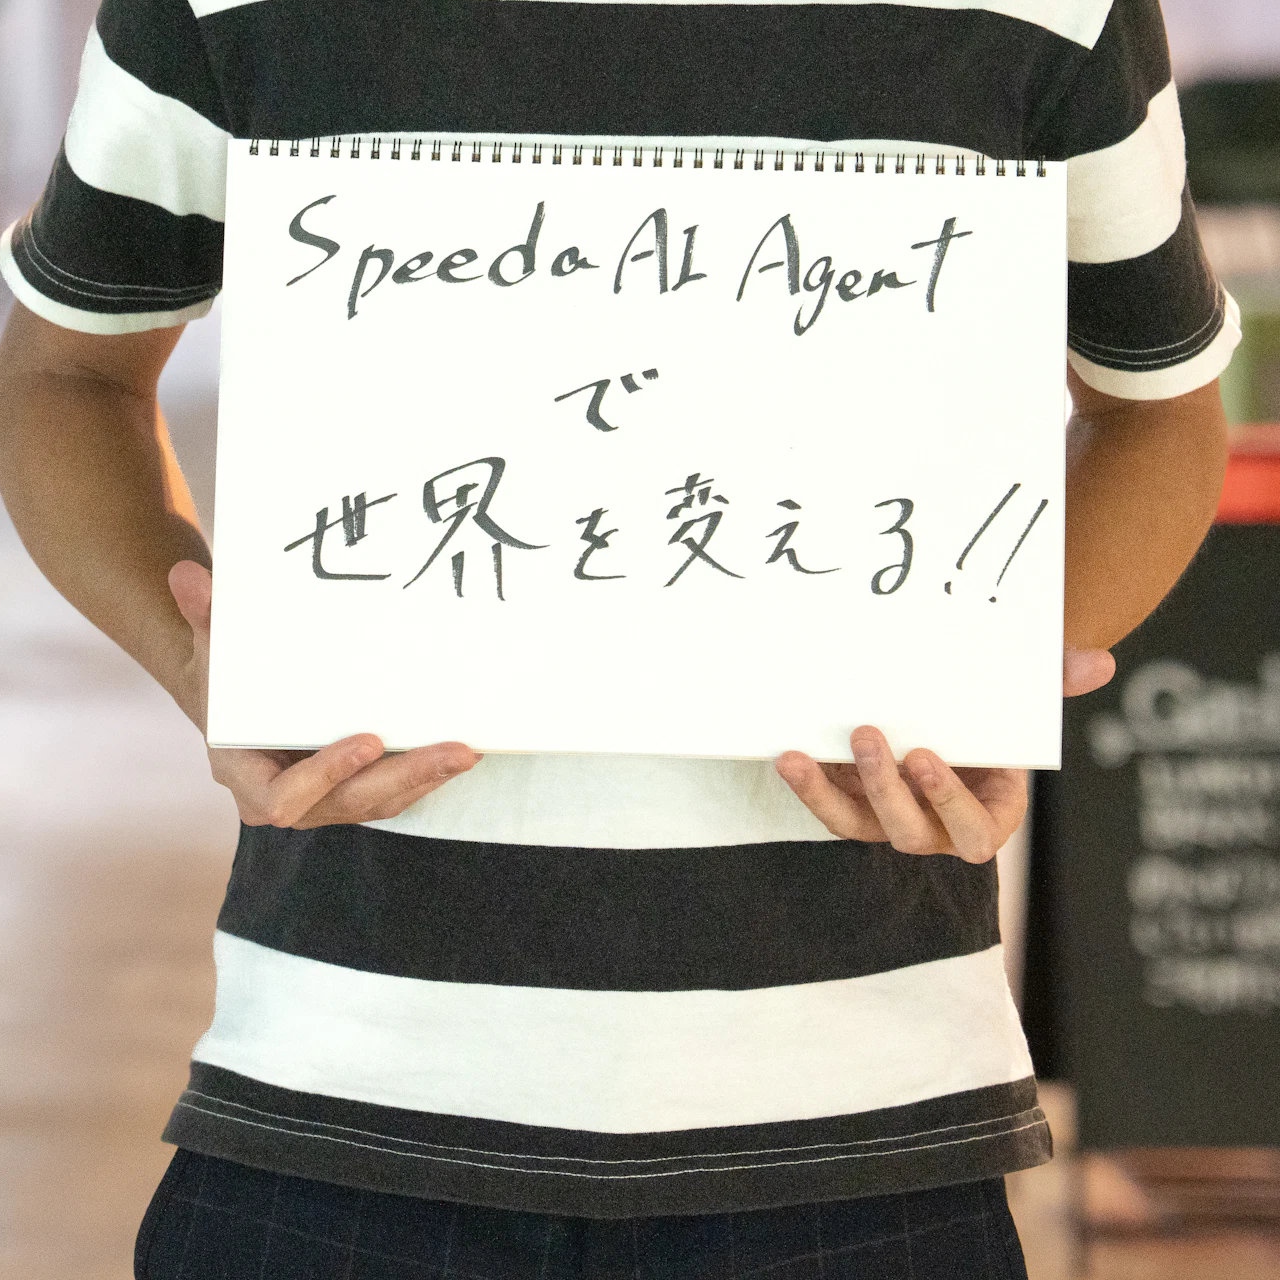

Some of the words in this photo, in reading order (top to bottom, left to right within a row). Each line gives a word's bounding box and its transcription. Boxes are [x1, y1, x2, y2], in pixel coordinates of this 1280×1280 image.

[286, 194, 601, 321] Speeda
[613, 207, 708, 296] AI
[735, 213, 974, 338] Agent
[554, 368, 660, 433] で
